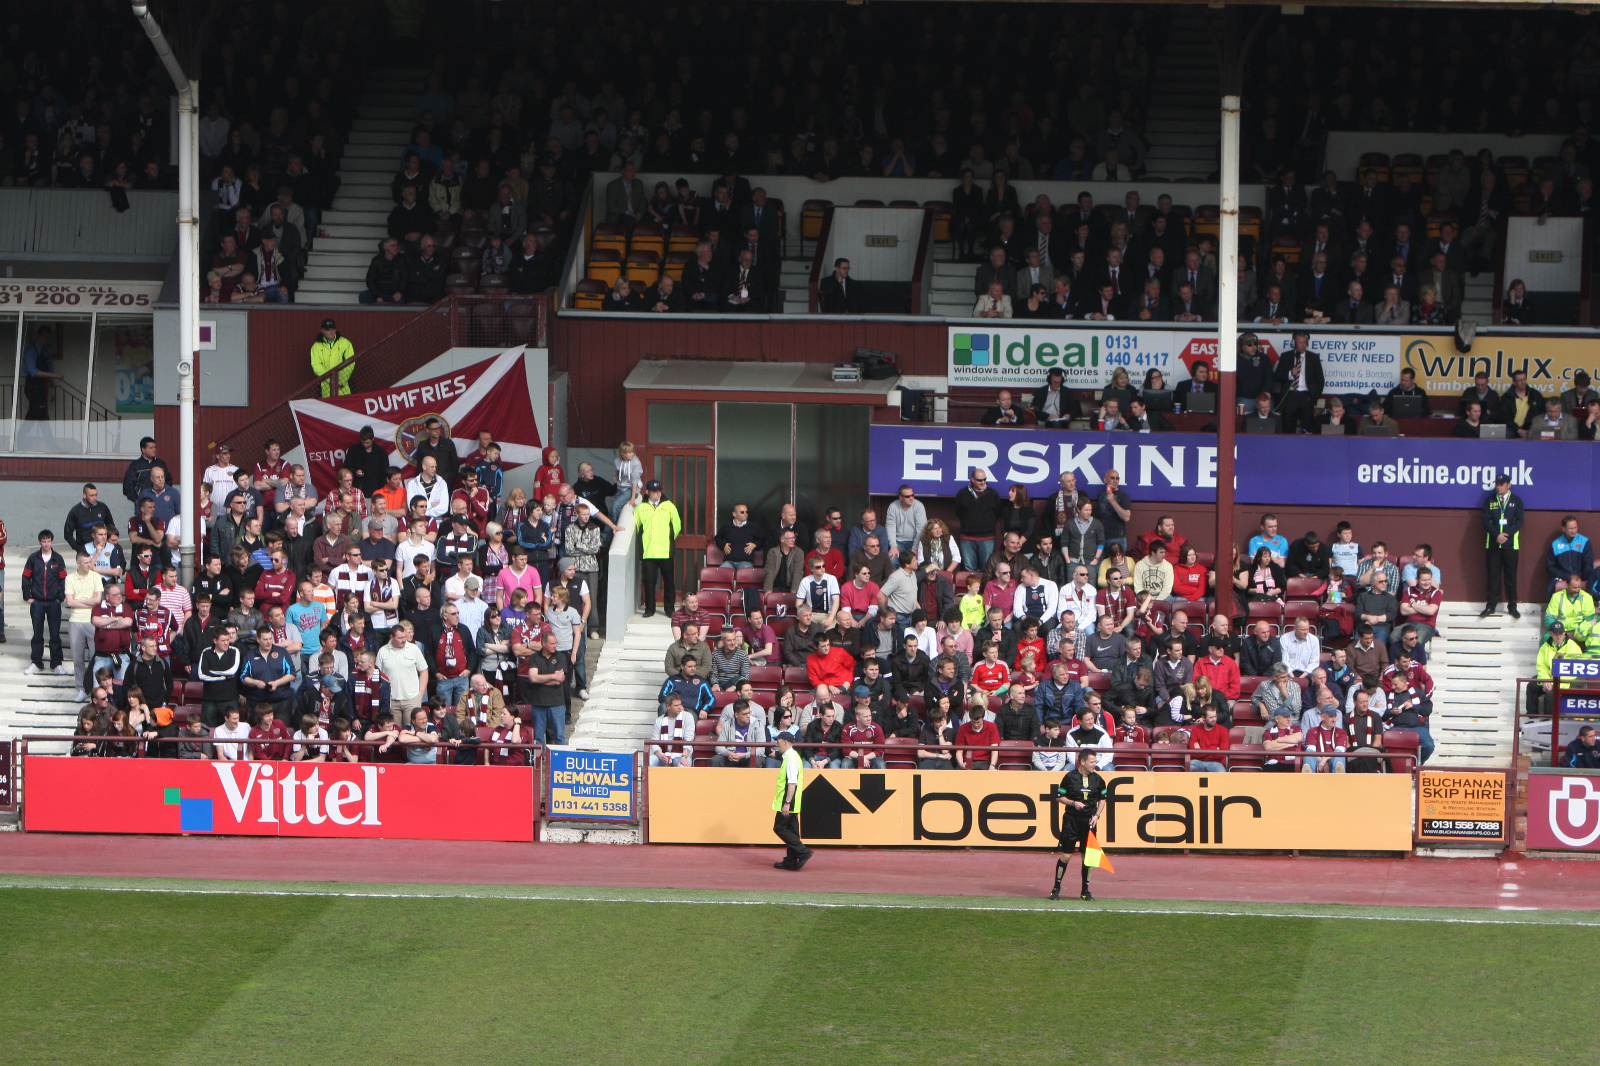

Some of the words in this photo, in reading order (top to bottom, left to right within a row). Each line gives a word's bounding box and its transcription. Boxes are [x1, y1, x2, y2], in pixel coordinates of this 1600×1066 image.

[871, 237, 890, 245] EXIT
[1535, 252, 1554, 260] EXIT
[35, 292, 80, 305] 200
[90, 293, 149, 306] 7205
[1105, 335, 1138, 349] 0131
[1311, 340, 1352, 350] EVERY
[1351, 340, 1376, 351] SKIP
[993, 334, 1099, 367] Ideal
[1105, 352, 1131, 365] 440
[1135, 353, 1169, 366] 4117
[1327, 353, 1358, 362] EVER
[1361, 353, 1395, 363] NEED
[954, 366, 998, 374] windows
[1001, 366, 1020, 374] and
[1023, 367, 1099, 376] consatories
[1324, 369, 1355, 378] Lothians
[1357, 370, 1363, 378] &
[1365, 370, 1393, 378] Borders
[364, 375, 467, 415] DUMFRIES
[309, 451, 329, 461] EST.
[329, 449, 349, 467] 19
[902, 438, 1237, 489] ERSKINE
[1357, 457, 1533, 491] erskine.orguk
[1566, 698, 1600, 708] ERS
[566, 757, 618, 771] BULLET
[553, 771, 629, 786] REMOVALS
[1422, 777, 1503, 788] BUCHANAN
[211, 762, 382, 825] Vittel
[573, 786, 609, 795] LIMITED
[1423, 788, 1459, 798] SKIP
[1464, 789, 1502, 799] HIRE
[553, 800, 578, 810] 0131
[581, 802, 599, 810] 441
[602, 803, 628, 811] 5358
[912, 775, 1262, 844] betfair
[1431, 820, 1453, 829] 0131
[1455, 821, 1474, 829] 558
[1474, 822, 1500, 830] 7888
